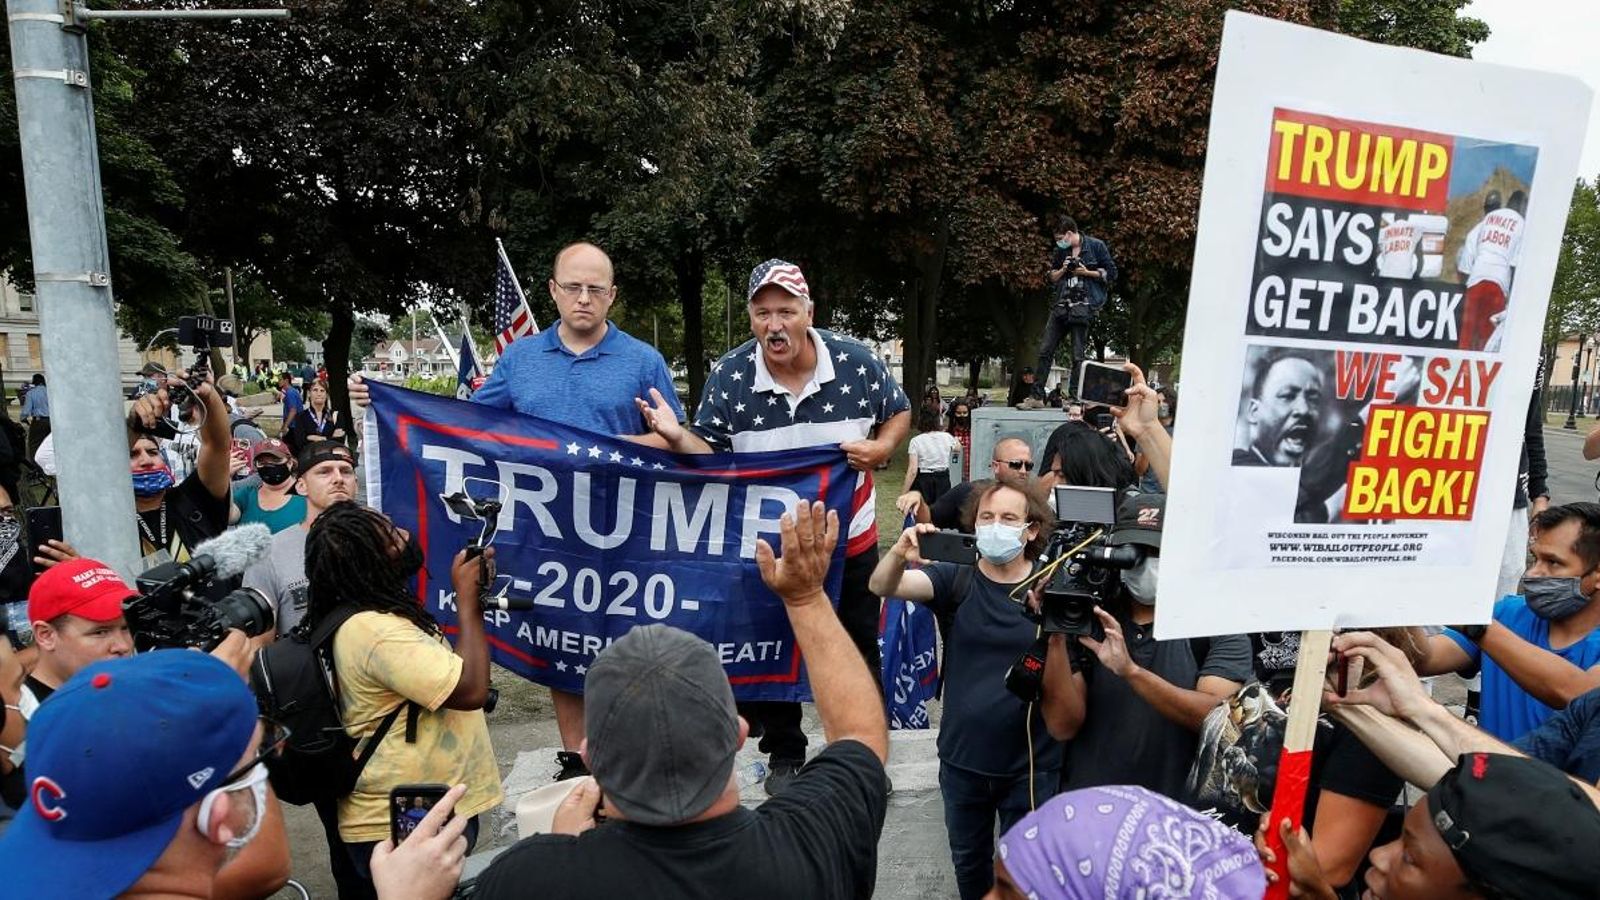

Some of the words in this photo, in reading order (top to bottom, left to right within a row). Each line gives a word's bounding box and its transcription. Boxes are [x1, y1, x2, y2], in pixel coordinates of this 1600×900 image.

[1273, 119, 1449, 199] TRUMP
[1261, 201, 1375, 266] SAYS
[1384, 240, 1411, 255] LABOR
[1482, 229, 1511, 249] LABOR
[1487, 215, 1518, 232] INMATE
[1253, 274, 1344, 332] GET
[1347, 283, 1464, 342] BACK
[1335, 349, 1403, 402] WE
[1422, 356, 1503, 408] SAY
[1366, 408, 1488, 461] FIGHT
[421, 444, 802, 559] TRUMP
[1137, 507, 1160, 522] 27
[1347, 466, 1475, 516] BACK!
[1267, 532, 1310, 540] WISCONSIN
[1347, 533, 1360, 541] THE
[1363, 533, 1388, 541] PEOPLE
[1390, 532, 1429, 540] MOVEMENT
[1269, 543, 1423, 553] WWW.WIBAILOUTPEOPLE.ORG
[438, 588, 511, 628] KEP
[717, 640, 783, 664] EAT!
[31, 776, 68, 823] C
